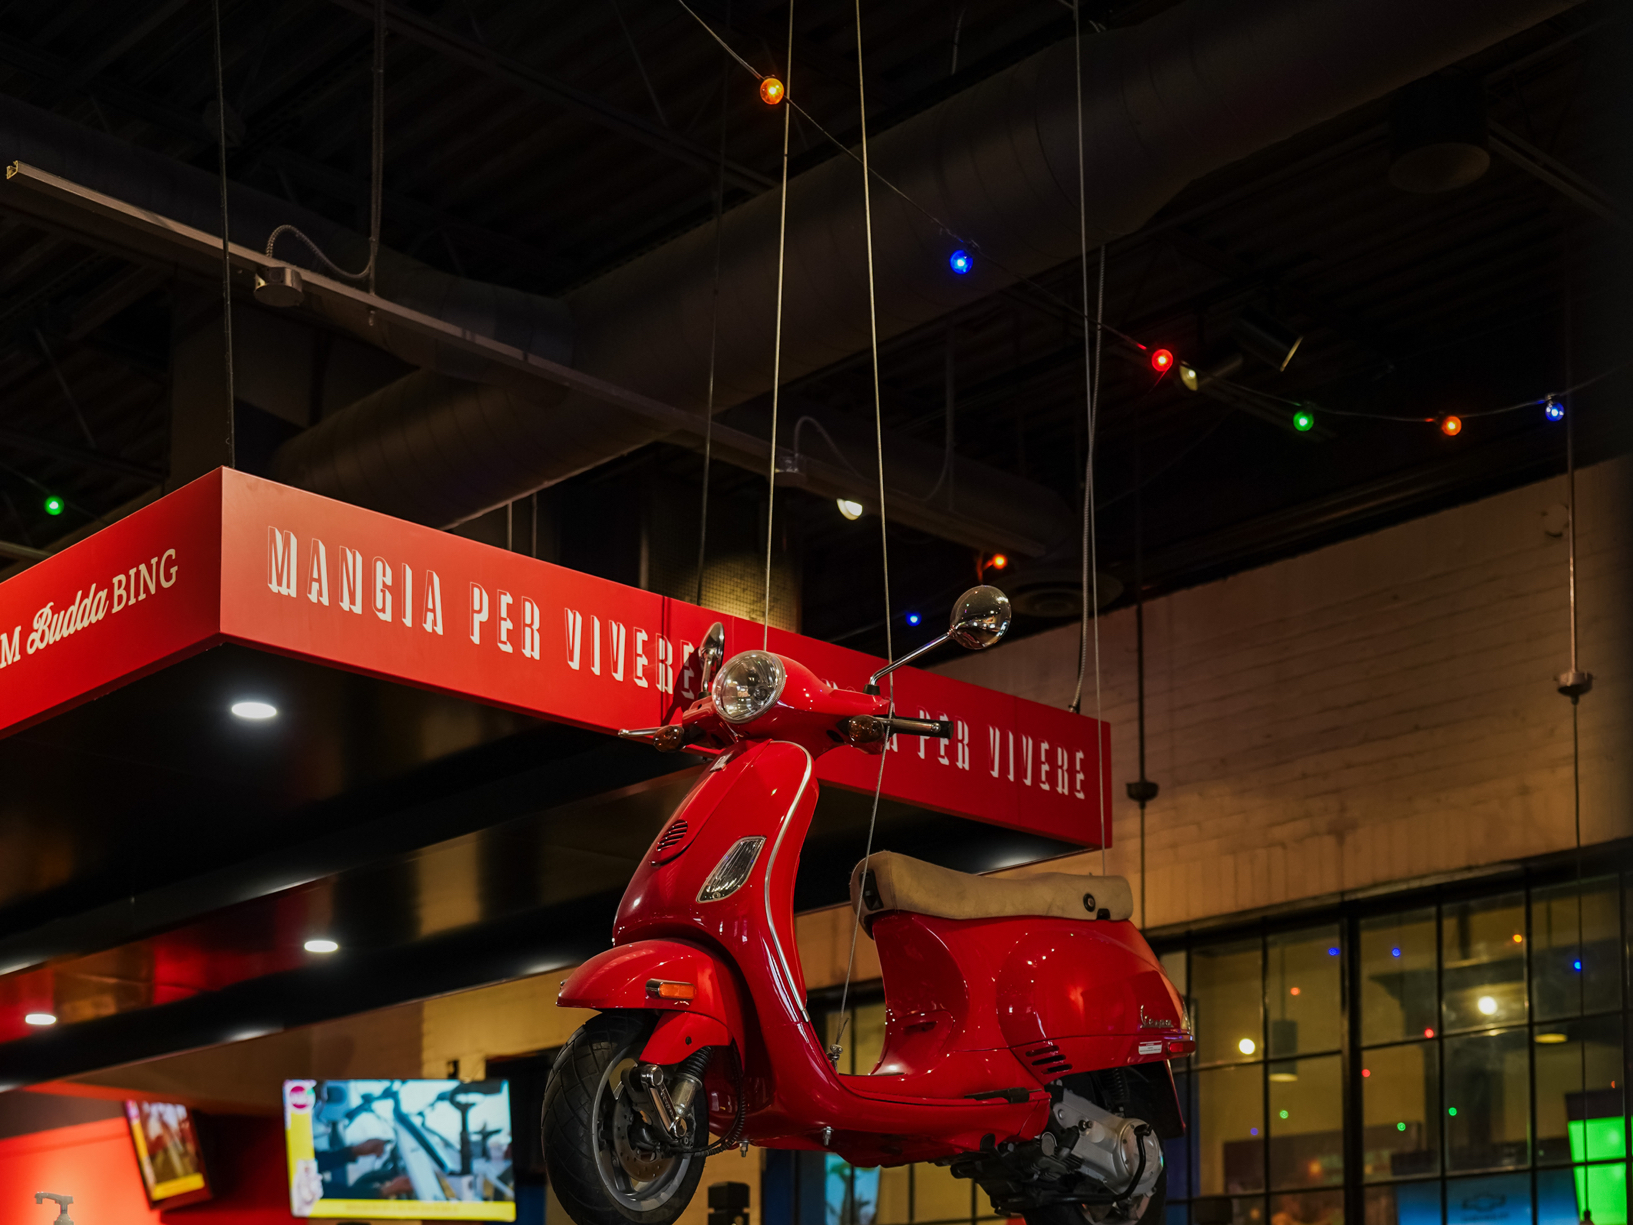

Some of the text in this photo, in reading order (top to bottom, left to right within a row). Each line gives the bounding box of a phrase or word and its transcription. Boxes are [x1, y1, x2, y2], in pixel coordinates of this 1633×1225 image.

[26, 582, 109, 655] Budda
[111, 548, 179, 614] BING
[268, 525, 695, 700] MANGIA PER VIVERE
[917, 705, 969, 771] PER
[987, 723, 1085, 800] VIVERE
